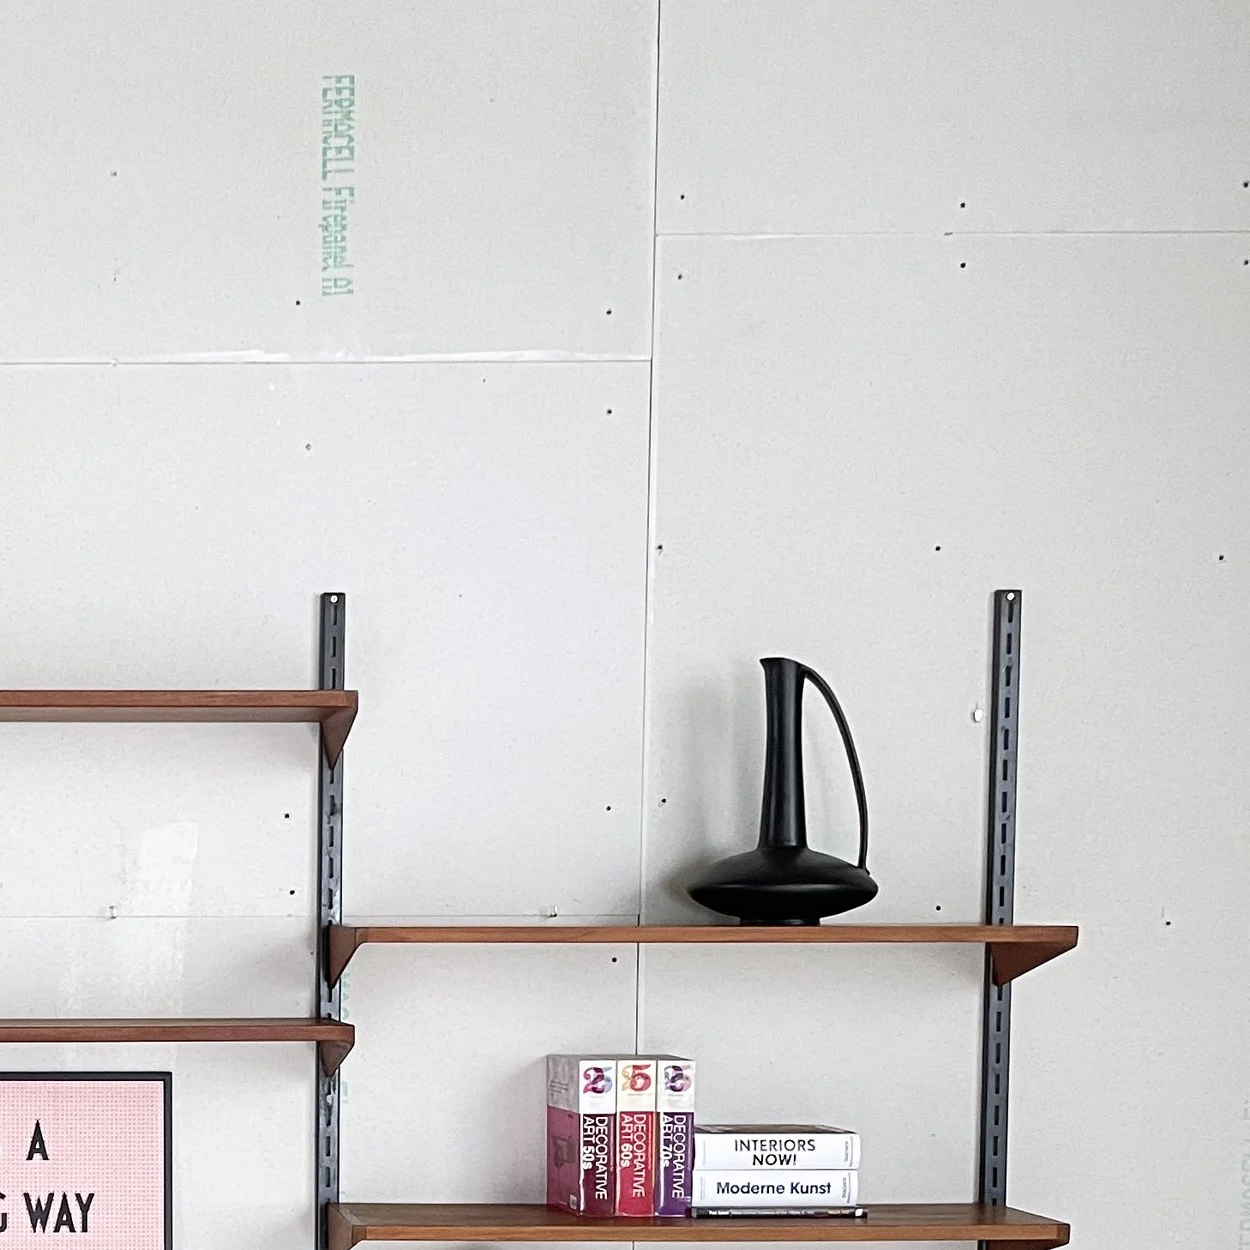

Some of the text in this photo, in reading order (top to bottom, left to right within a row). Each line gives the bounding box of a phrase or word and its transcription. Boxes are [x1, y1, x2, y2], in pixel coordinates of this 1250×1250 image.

[319, 75, 355, 297] FERMACELL Firepanel A1
[26, 1119, 50, 1161] A
[582, 1116, 596, 1170] ART 50s
[595, 1116, 608, 1200] DECORATIVE
[620, 1113, 634, 1168] ART 60s
[632, 1113, 646, 1198] DECORATIVE
[661, 1115, 674, 1168] ART 70s
[672, 1114, 687, 1199] DECORATIVE
[734, 1139, 816, 1152] INTERIORS
[752, 1154, 797, 1166] NOW!
[23, 1191, 95, 1233] WAY
[716, 1182, 785, 1195] Moderne
[790, 1182, 831, 1195] Kunst
